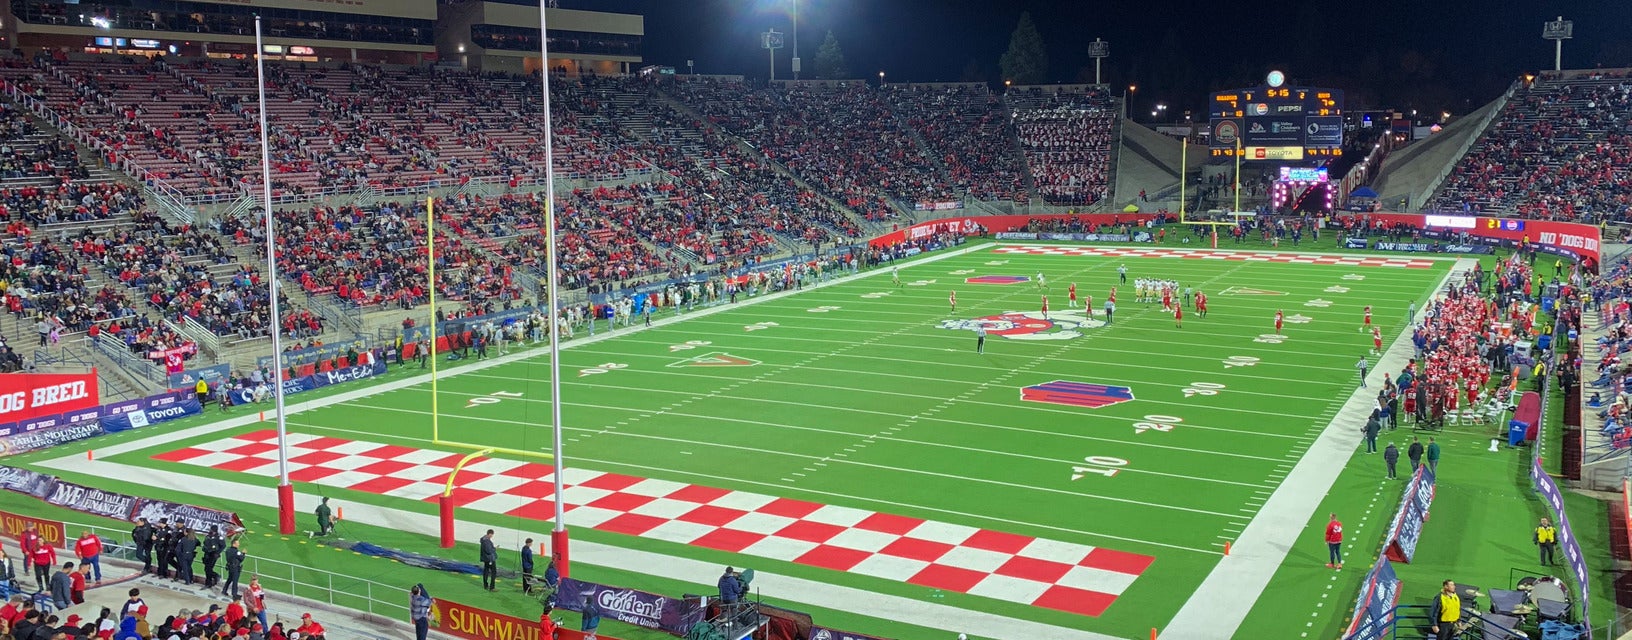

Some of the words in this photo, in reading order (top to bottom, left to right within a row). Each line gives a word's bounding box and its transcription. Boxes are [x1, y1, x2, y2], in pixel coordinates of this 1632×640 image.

[31, 380, 89, 408] BRED.
[148, 406, 186, 420] TOYOTA
[43, 422, 100, 441] MOUNTAIN
[618, 613, 638, 625] Credit
[639, 617, 659, 629] Union
